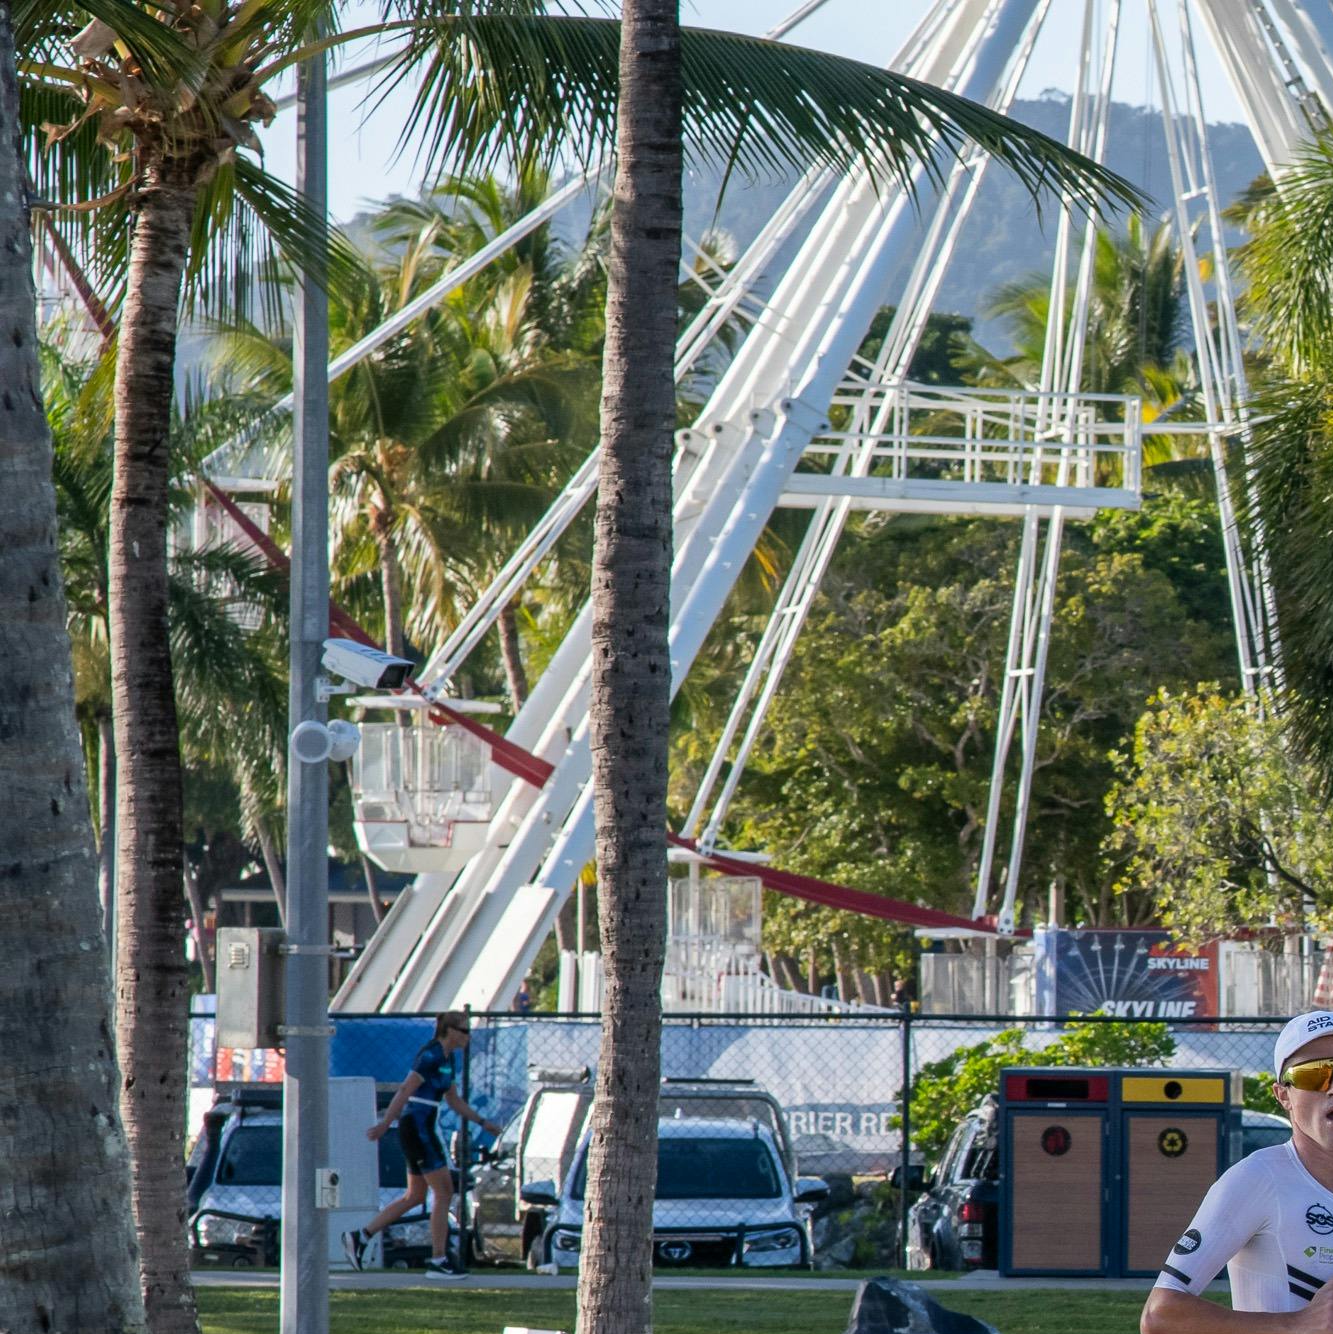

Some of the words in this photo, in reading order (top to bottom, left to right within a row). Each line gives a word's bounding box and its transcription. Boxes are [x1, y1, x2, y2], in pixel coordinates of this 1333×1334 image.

[1147, 958, 1209, 970] SKYLINE
[1307, 1016, 1331, 1027] AID
[782, 1111, 853, 1137] RIER
